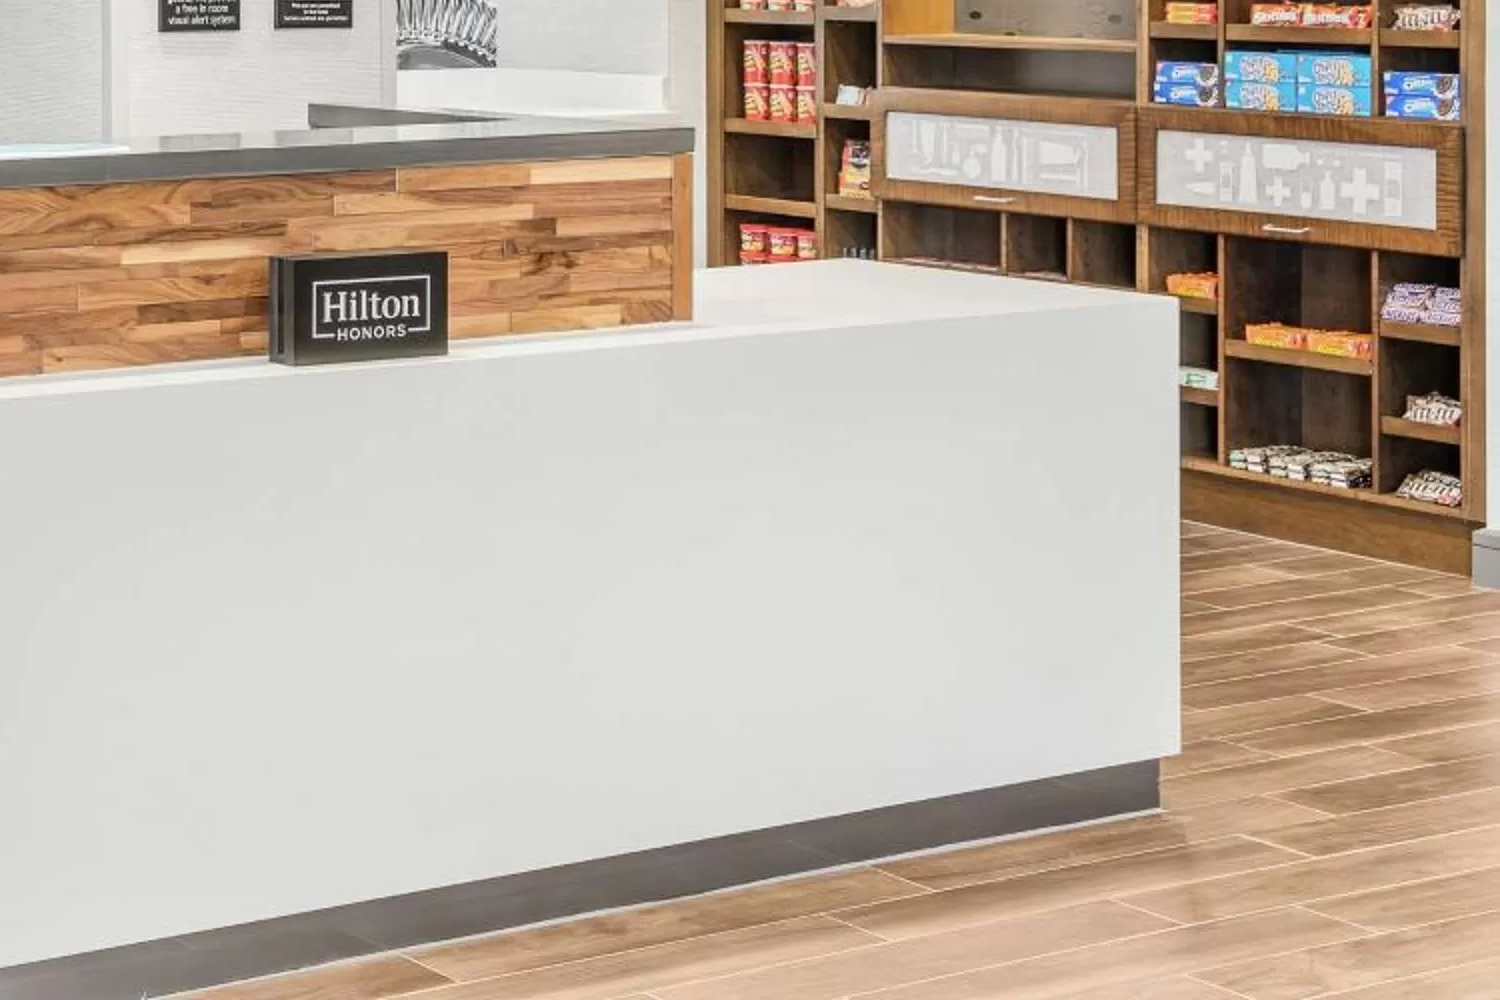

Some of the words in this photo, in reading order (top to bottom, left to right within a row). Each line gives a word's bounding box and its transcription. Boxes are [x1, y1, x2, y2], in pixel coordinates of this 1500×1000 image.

[208, 4, 229, 14] room
[322, 289, 421, 324] Hilton
[336, 323, 407, 342] HONORS
